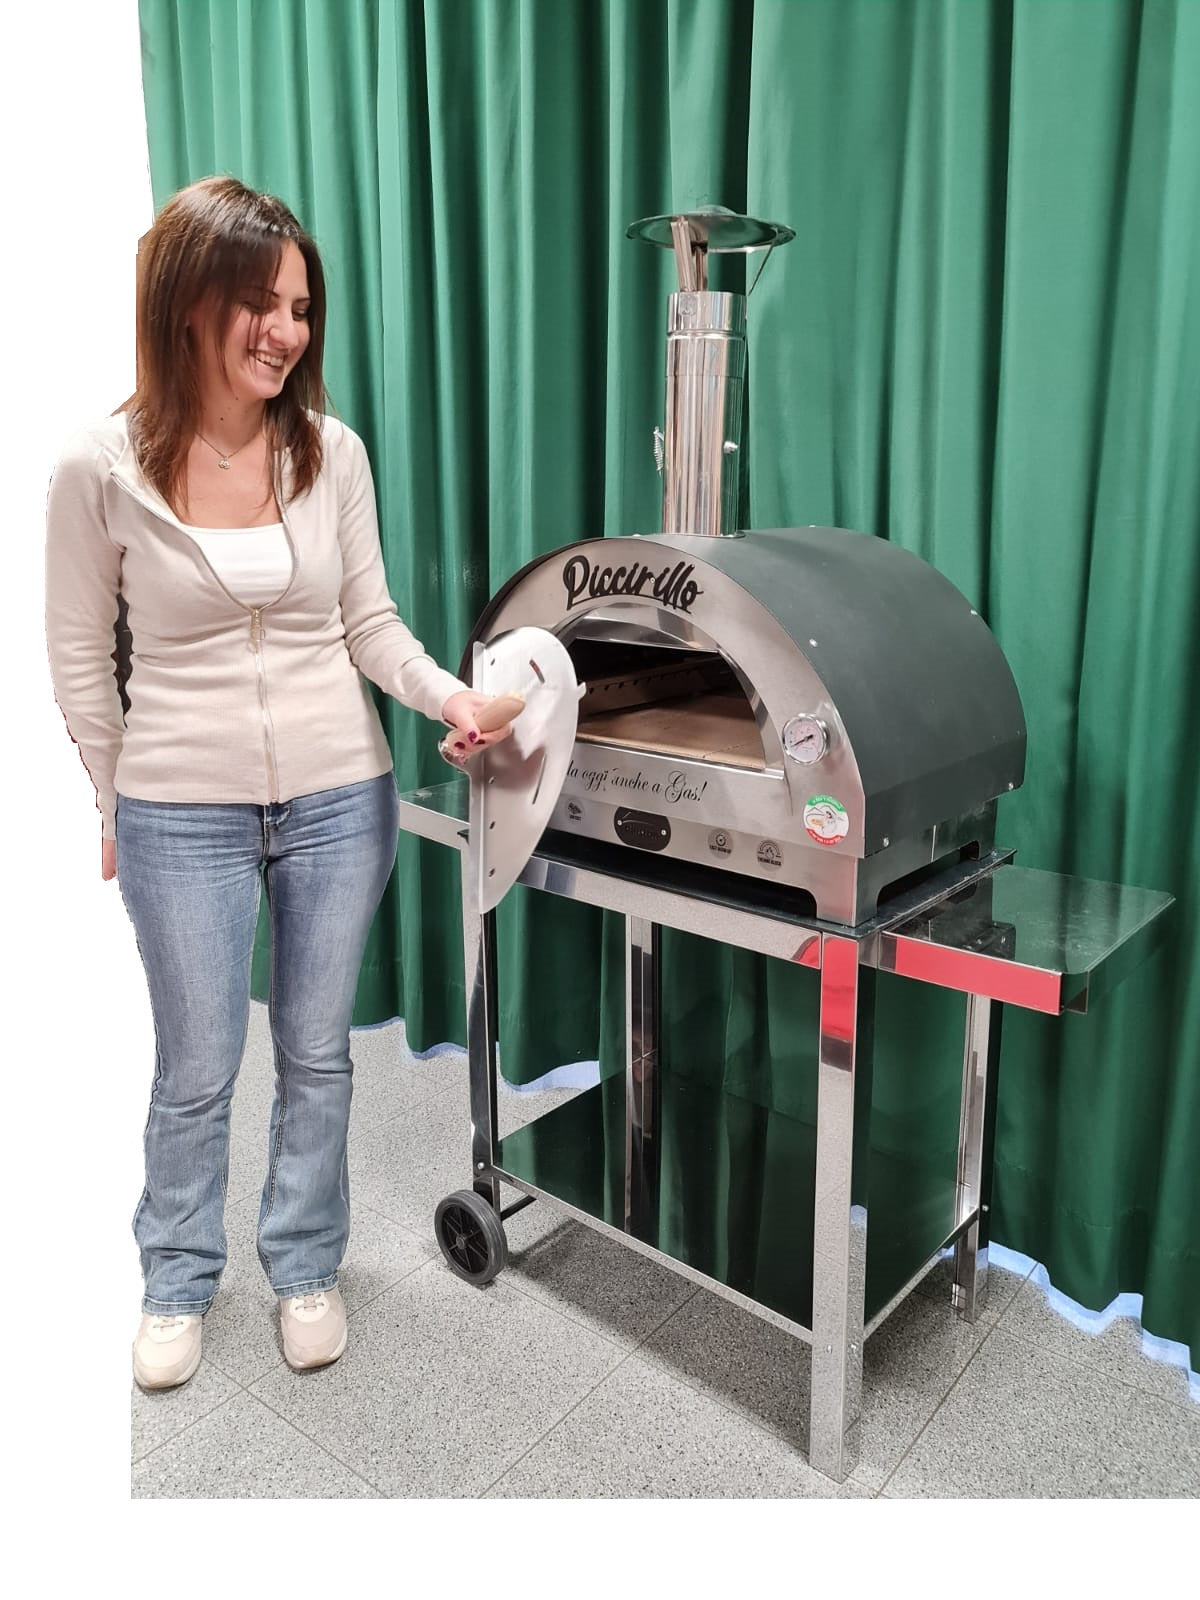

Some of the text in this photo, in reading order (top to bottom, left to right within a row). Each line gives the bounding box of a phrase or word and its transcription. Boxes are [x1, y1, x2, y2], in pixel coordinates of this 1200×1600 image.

[563, 555, 704, 613] Piccirillo
[582, 770, 609, 792] oggi
[611, 771, 649, 790] anche
[651, 783, 661, 792] a
[665, 770, 708, 803] Gas!
